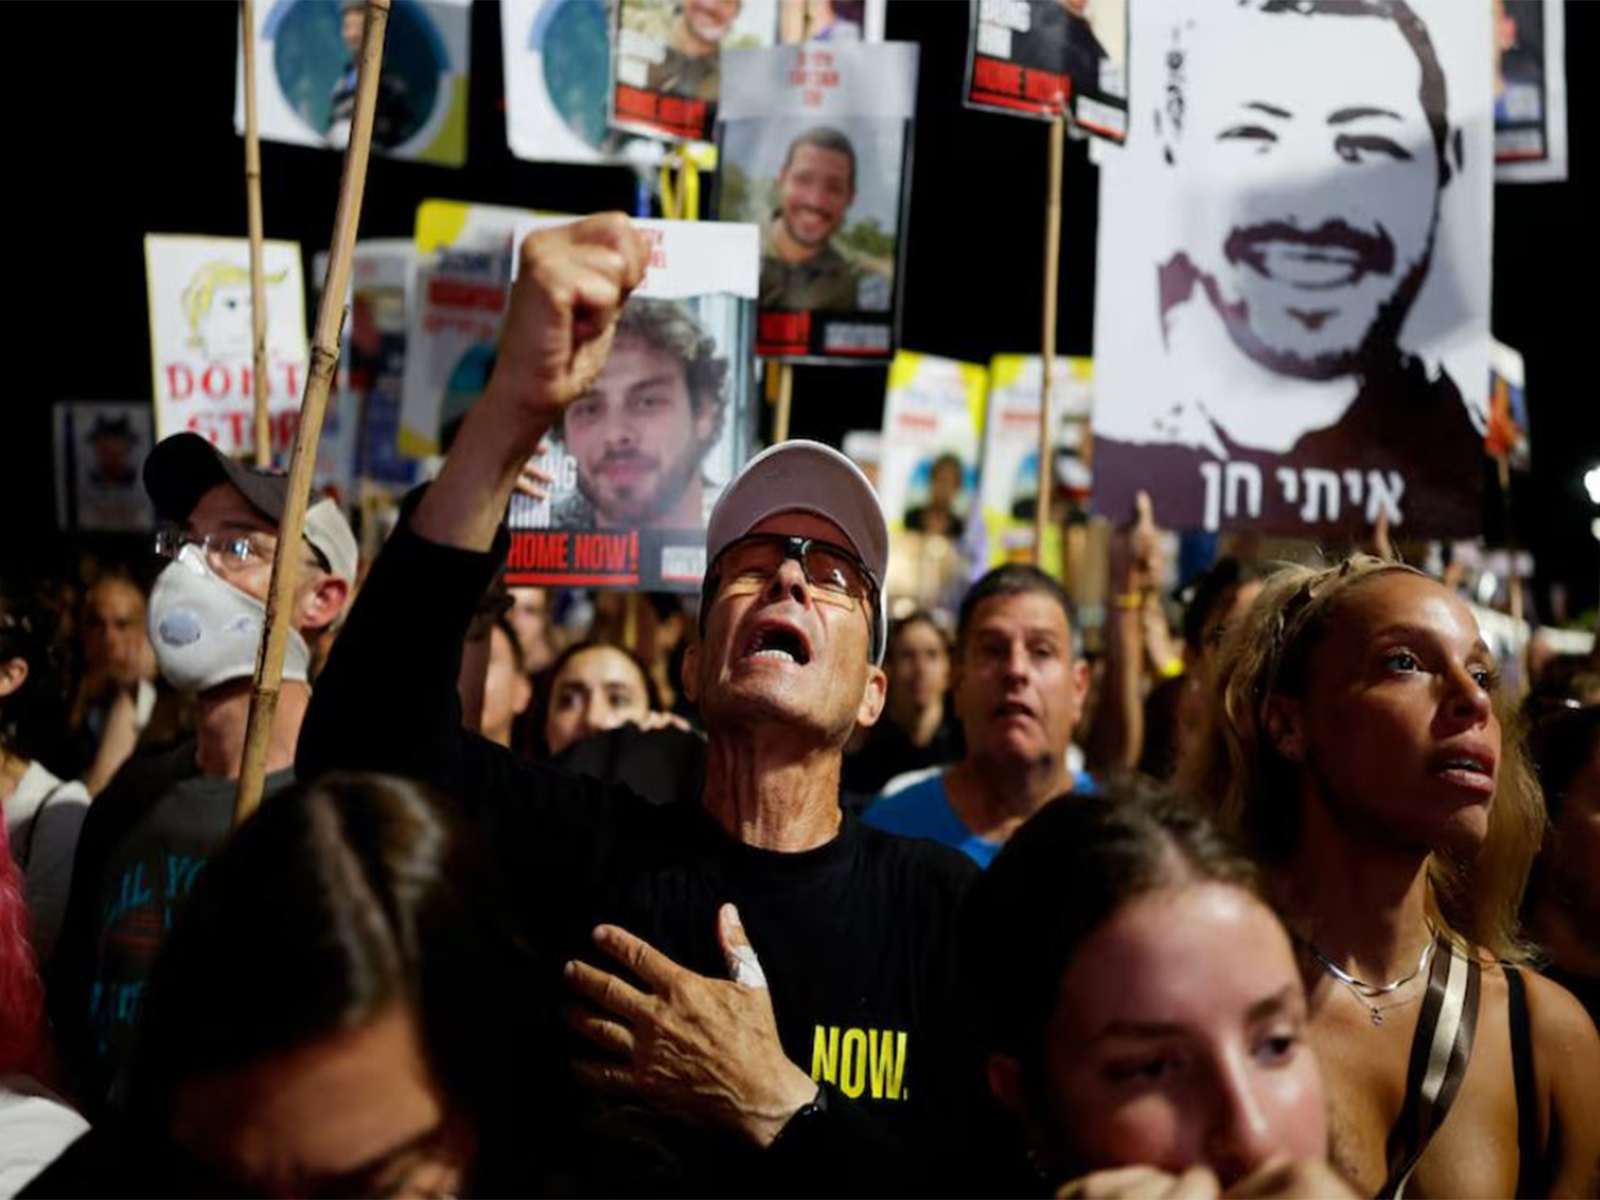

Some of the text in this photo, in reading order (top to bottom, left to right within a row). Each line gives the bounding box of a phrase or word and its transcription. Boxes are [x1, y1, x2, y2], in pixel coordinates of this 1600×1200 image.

[1199, 460, 1406, 533] איתי חן
[506, 533, 569, 570] HOME
[574, 529, 640, 571] NOW!
[810, 1023, 909, 1102] NOW.
